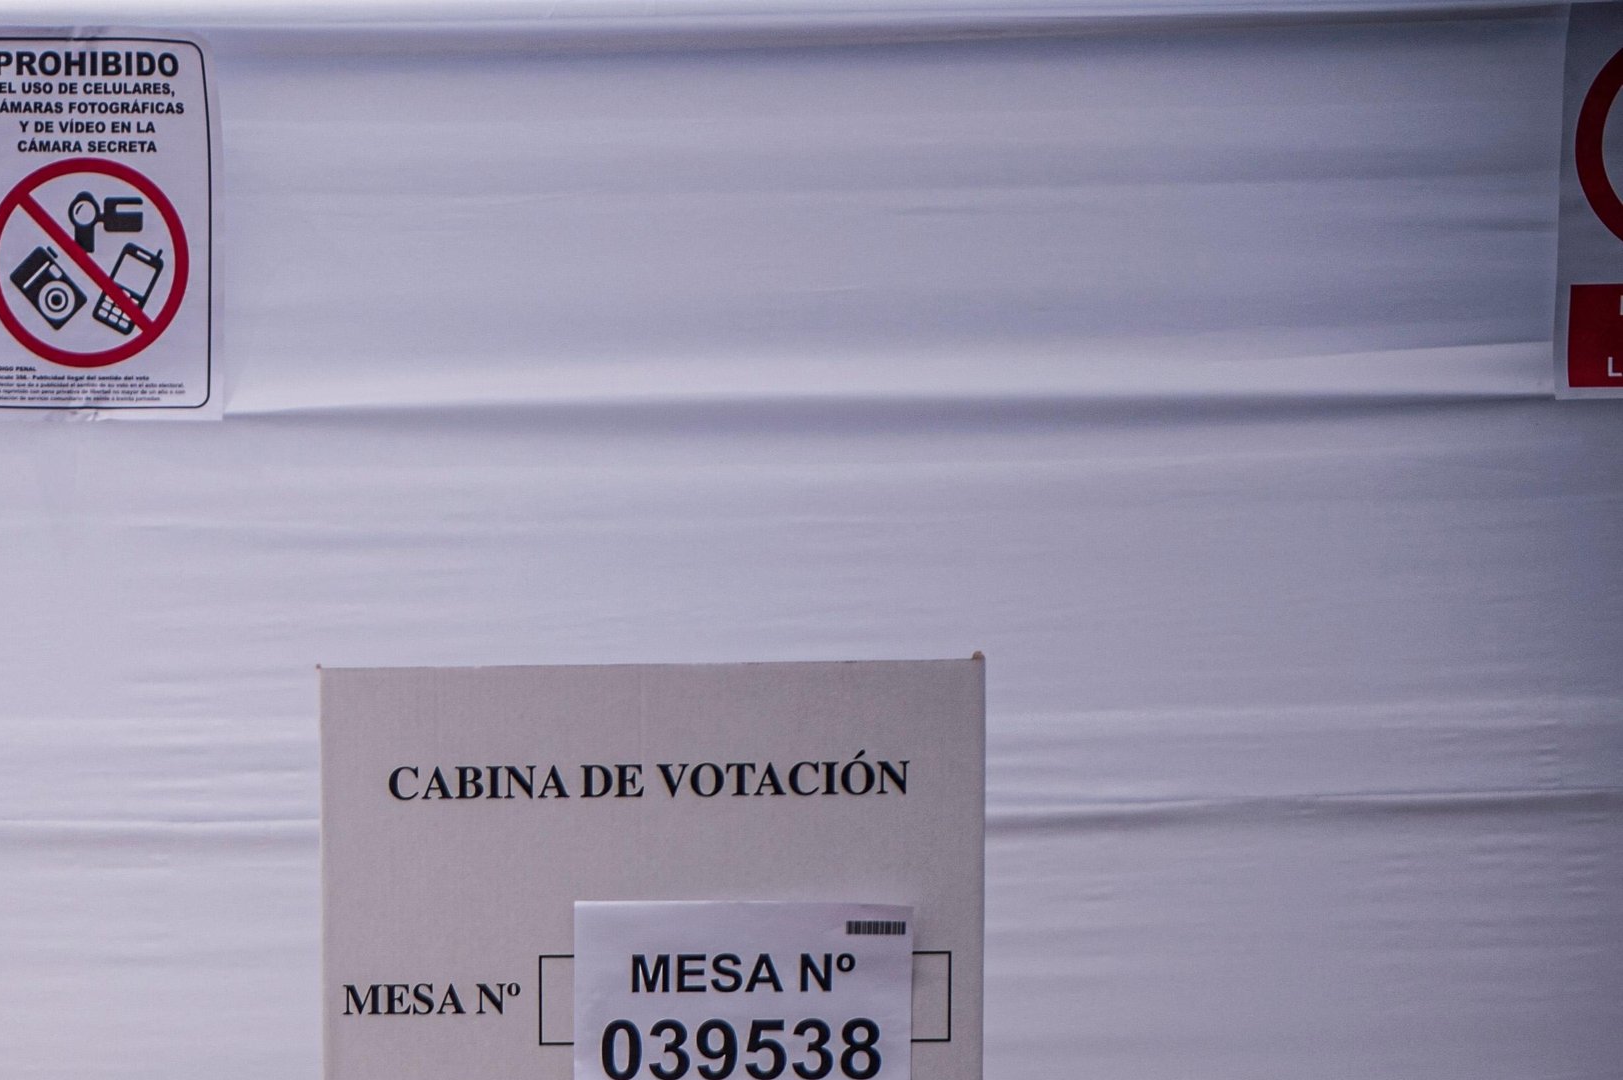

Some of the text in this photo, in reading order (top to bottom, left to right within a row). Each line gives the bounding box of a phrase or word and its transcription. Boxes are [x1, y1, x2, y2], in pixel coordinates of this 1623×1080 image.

[21, 81, 53, 95] USO
[58, 81, 78, 94] DE
[82, 81, 176, 97] CELULARES,
[68, 98, 185, 115] FOTOGRÁFICAS
[19, 118, 156, 134] Y DE VÍDEO EN LA
[17, 137, 158, 154] CÁMARA SECRETA
[388, 749, 911, 802] CABINA DE VOTACIÓN
[630, 952, 856, 994] MESA Nº
[342, 982, 522, 1016] MESA Nº
